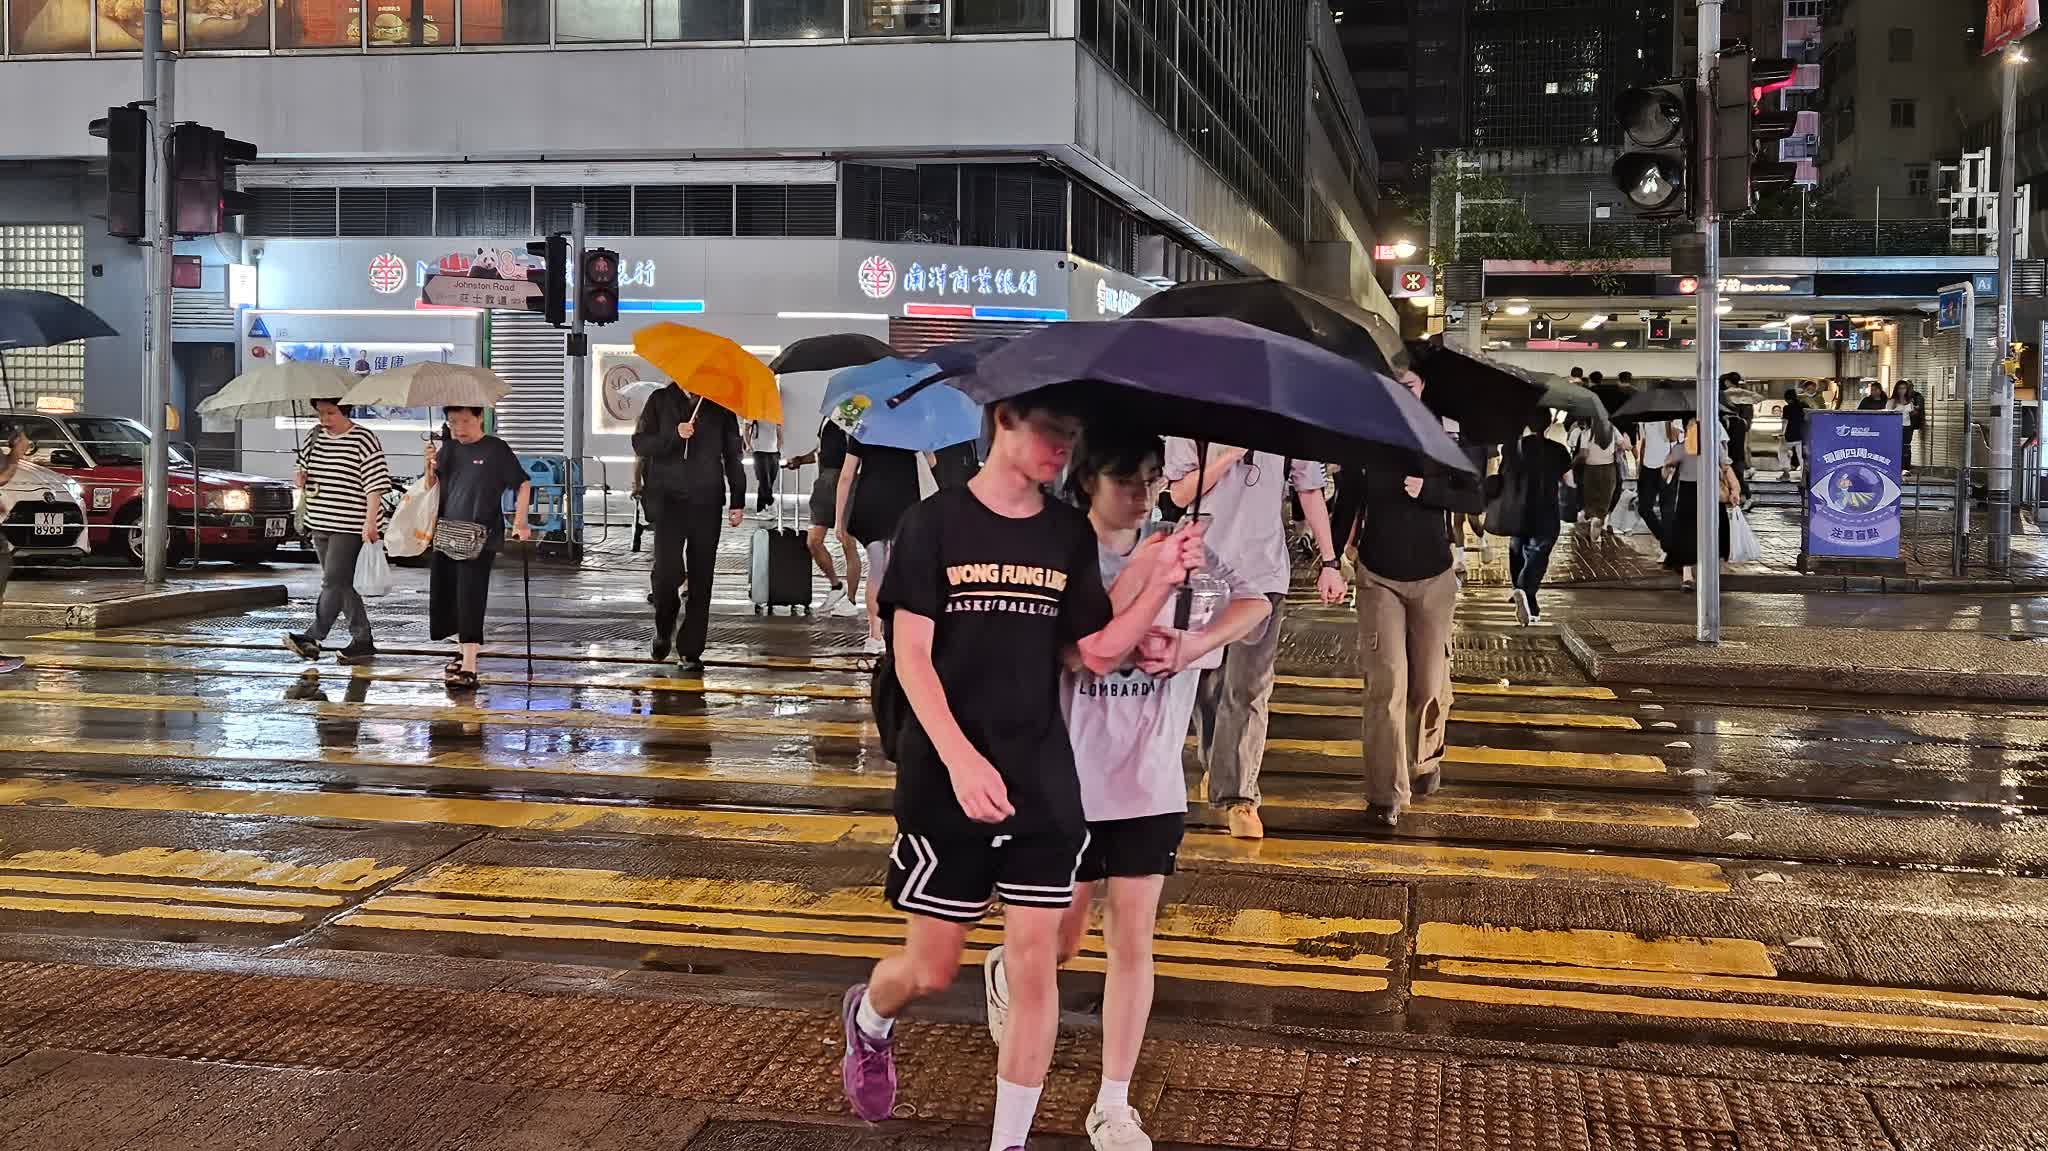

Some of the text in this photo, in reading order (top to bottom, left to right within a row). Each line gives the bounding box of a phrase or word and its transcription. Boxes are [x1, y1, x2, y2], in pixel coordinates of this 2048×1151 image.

[454, 280, 515, 292] Johnston Road
[903, 261, 1038, 297] 南洋商業銀行
[43, 513, 56, 525] XY
[1830, 527, 1880, 541] 注意盲點
[946, 563, 999, 586] WONG
[1001, 564, 1045, 588] FUNG
